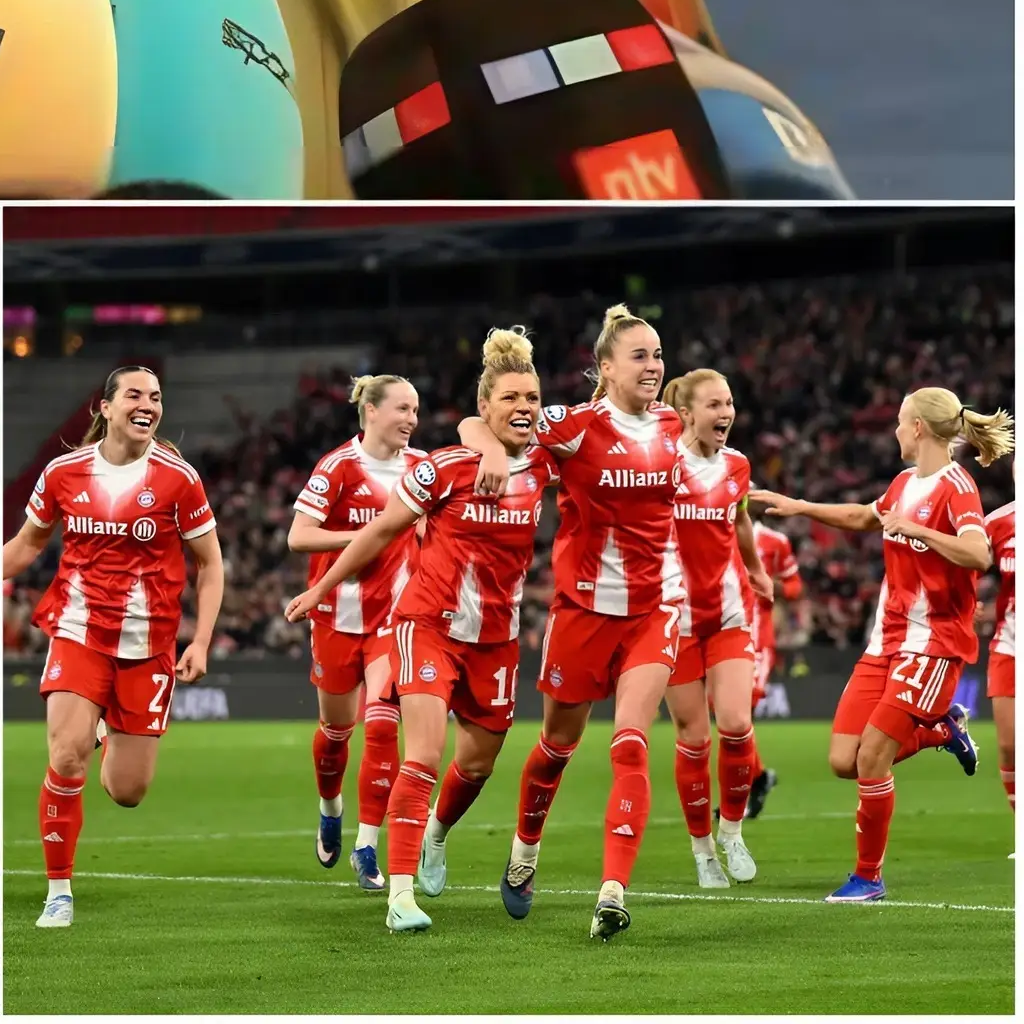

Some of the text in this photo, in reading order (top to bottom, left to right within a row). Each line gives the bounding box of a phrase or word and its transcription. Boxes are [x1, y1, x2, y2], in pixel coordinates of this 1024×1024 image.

[598, 469, 668, 487] Allianz
[67, 515, 128, 536] Allianz
[461, 503, 531, 524] Allianz
[658, 604, 680, 638] 7
[891, 652, 930, 690] 21
[148, 673, 169, 713] 2
